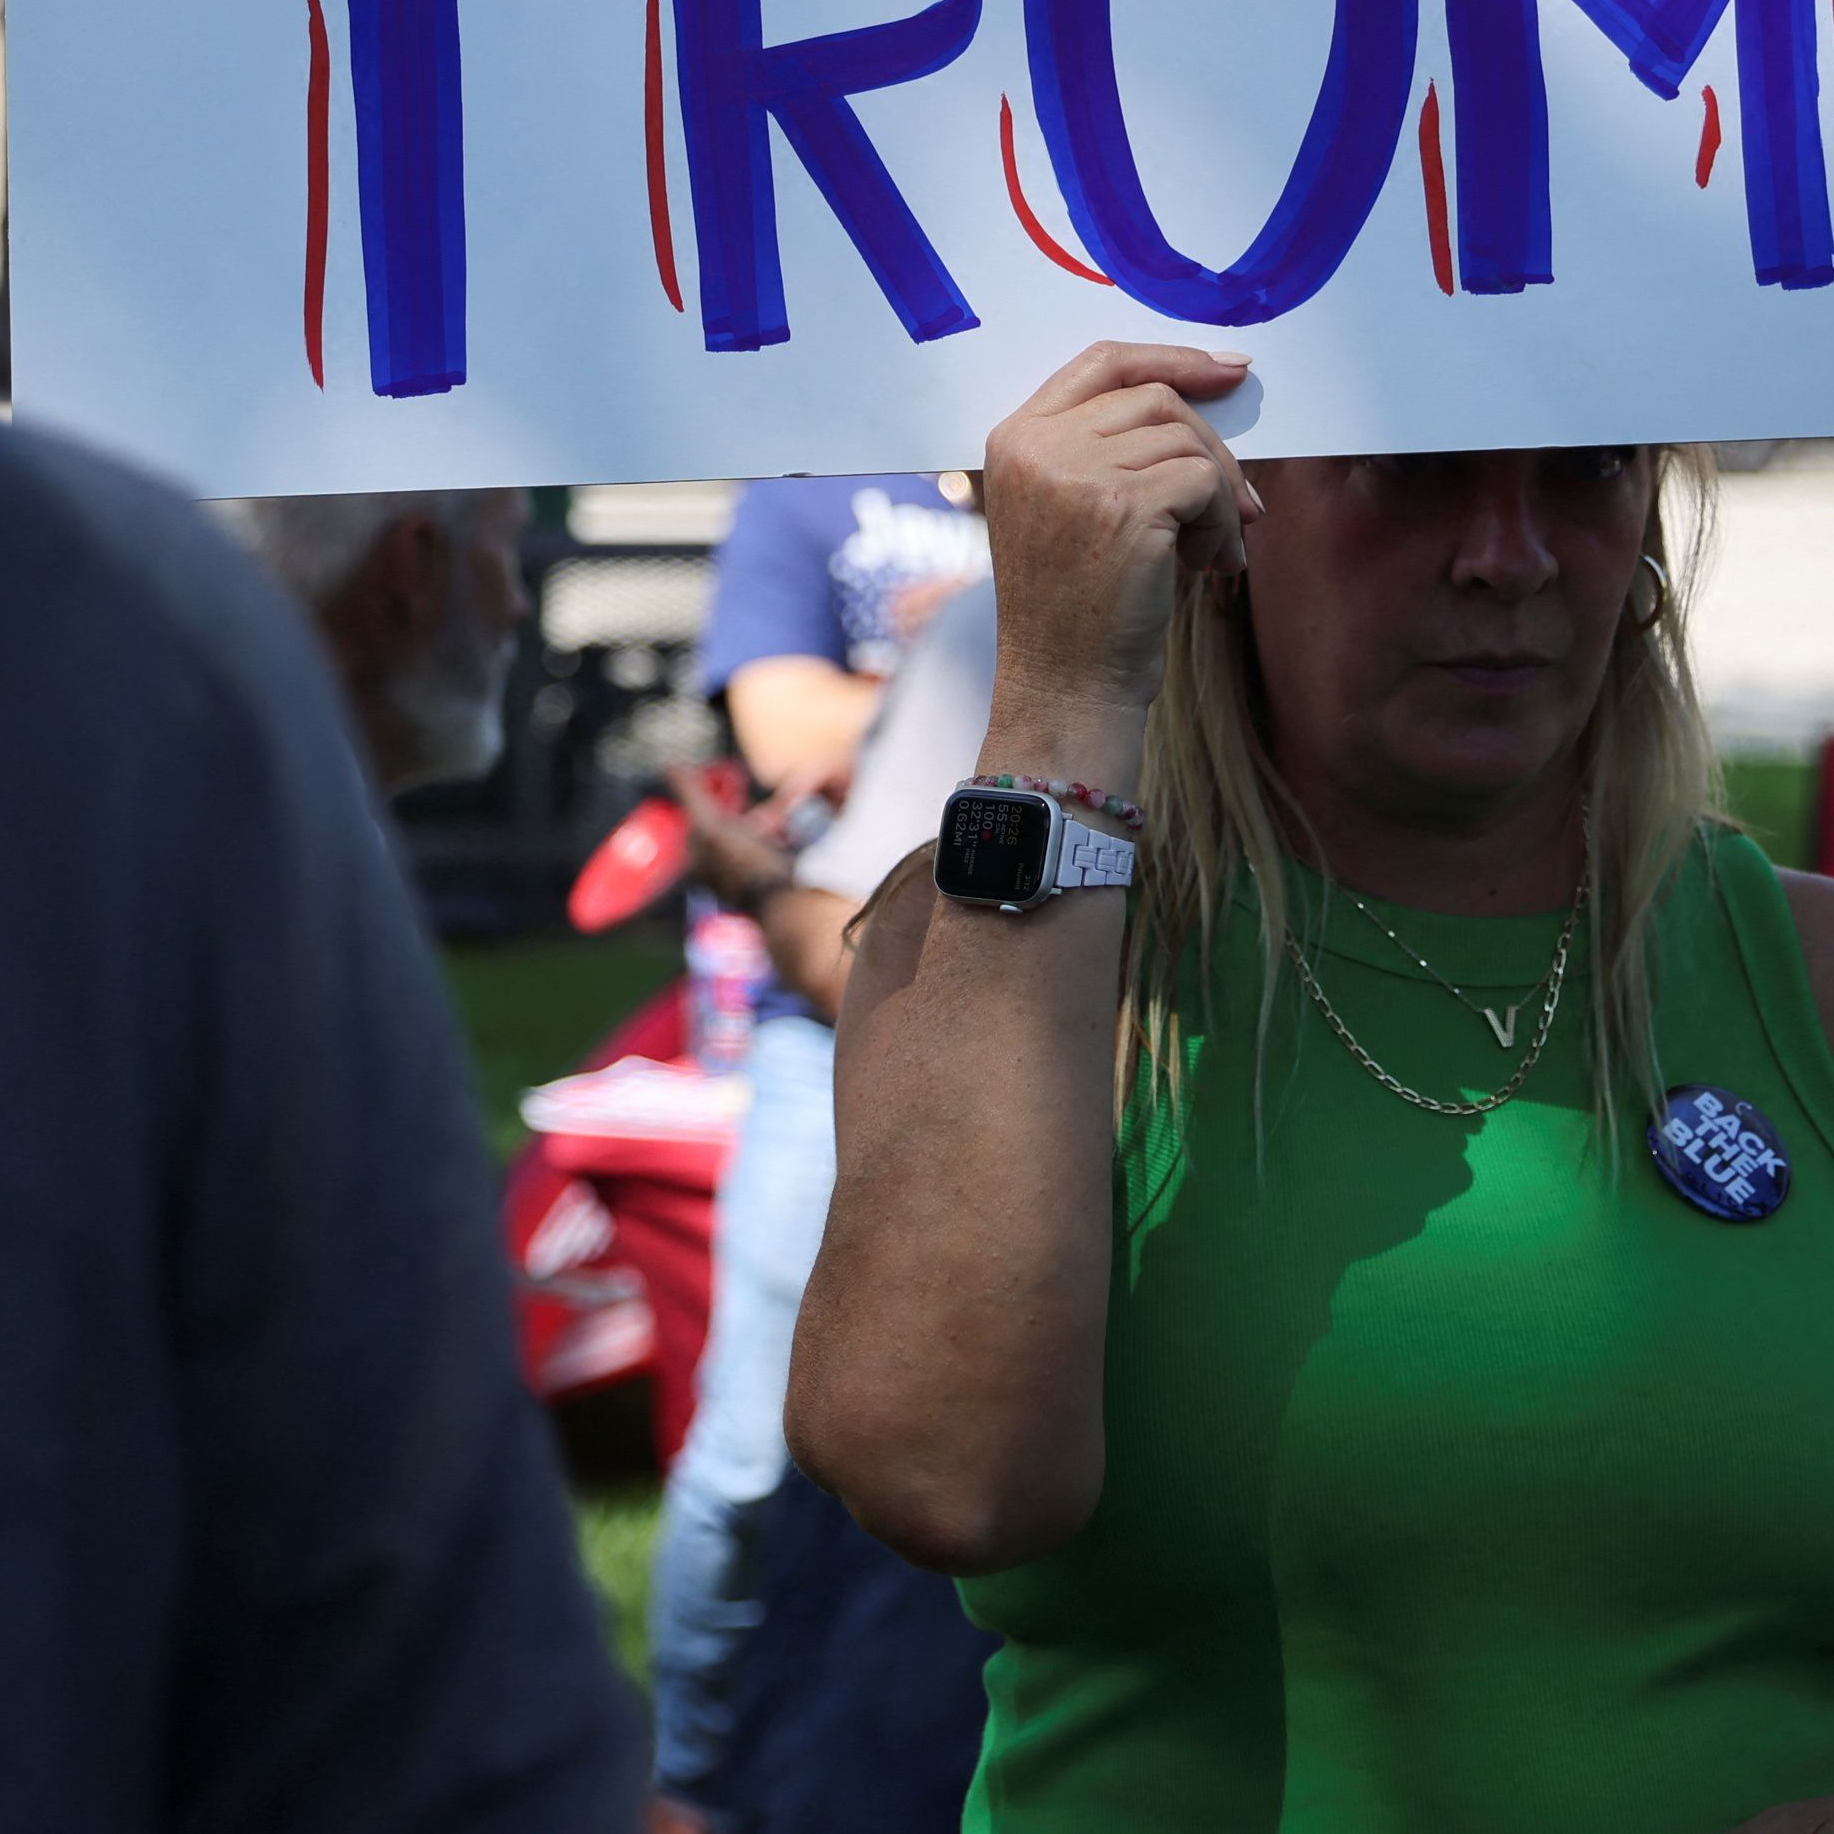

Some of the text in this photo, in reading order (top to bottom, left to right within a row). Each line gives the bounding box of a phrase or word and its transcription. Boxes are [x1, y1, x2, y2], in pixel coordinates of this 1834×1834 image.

[982, 804, 995, 830] 100
[997, 804, 1009, 822] 55
[1007, 805, 1022, 846] 20:26
[1693, 1091, 1786, 1178] BACK
[1694, 1115, 1759, 1178] THE
[1662, 1117, 1756, 1205] BLUE
